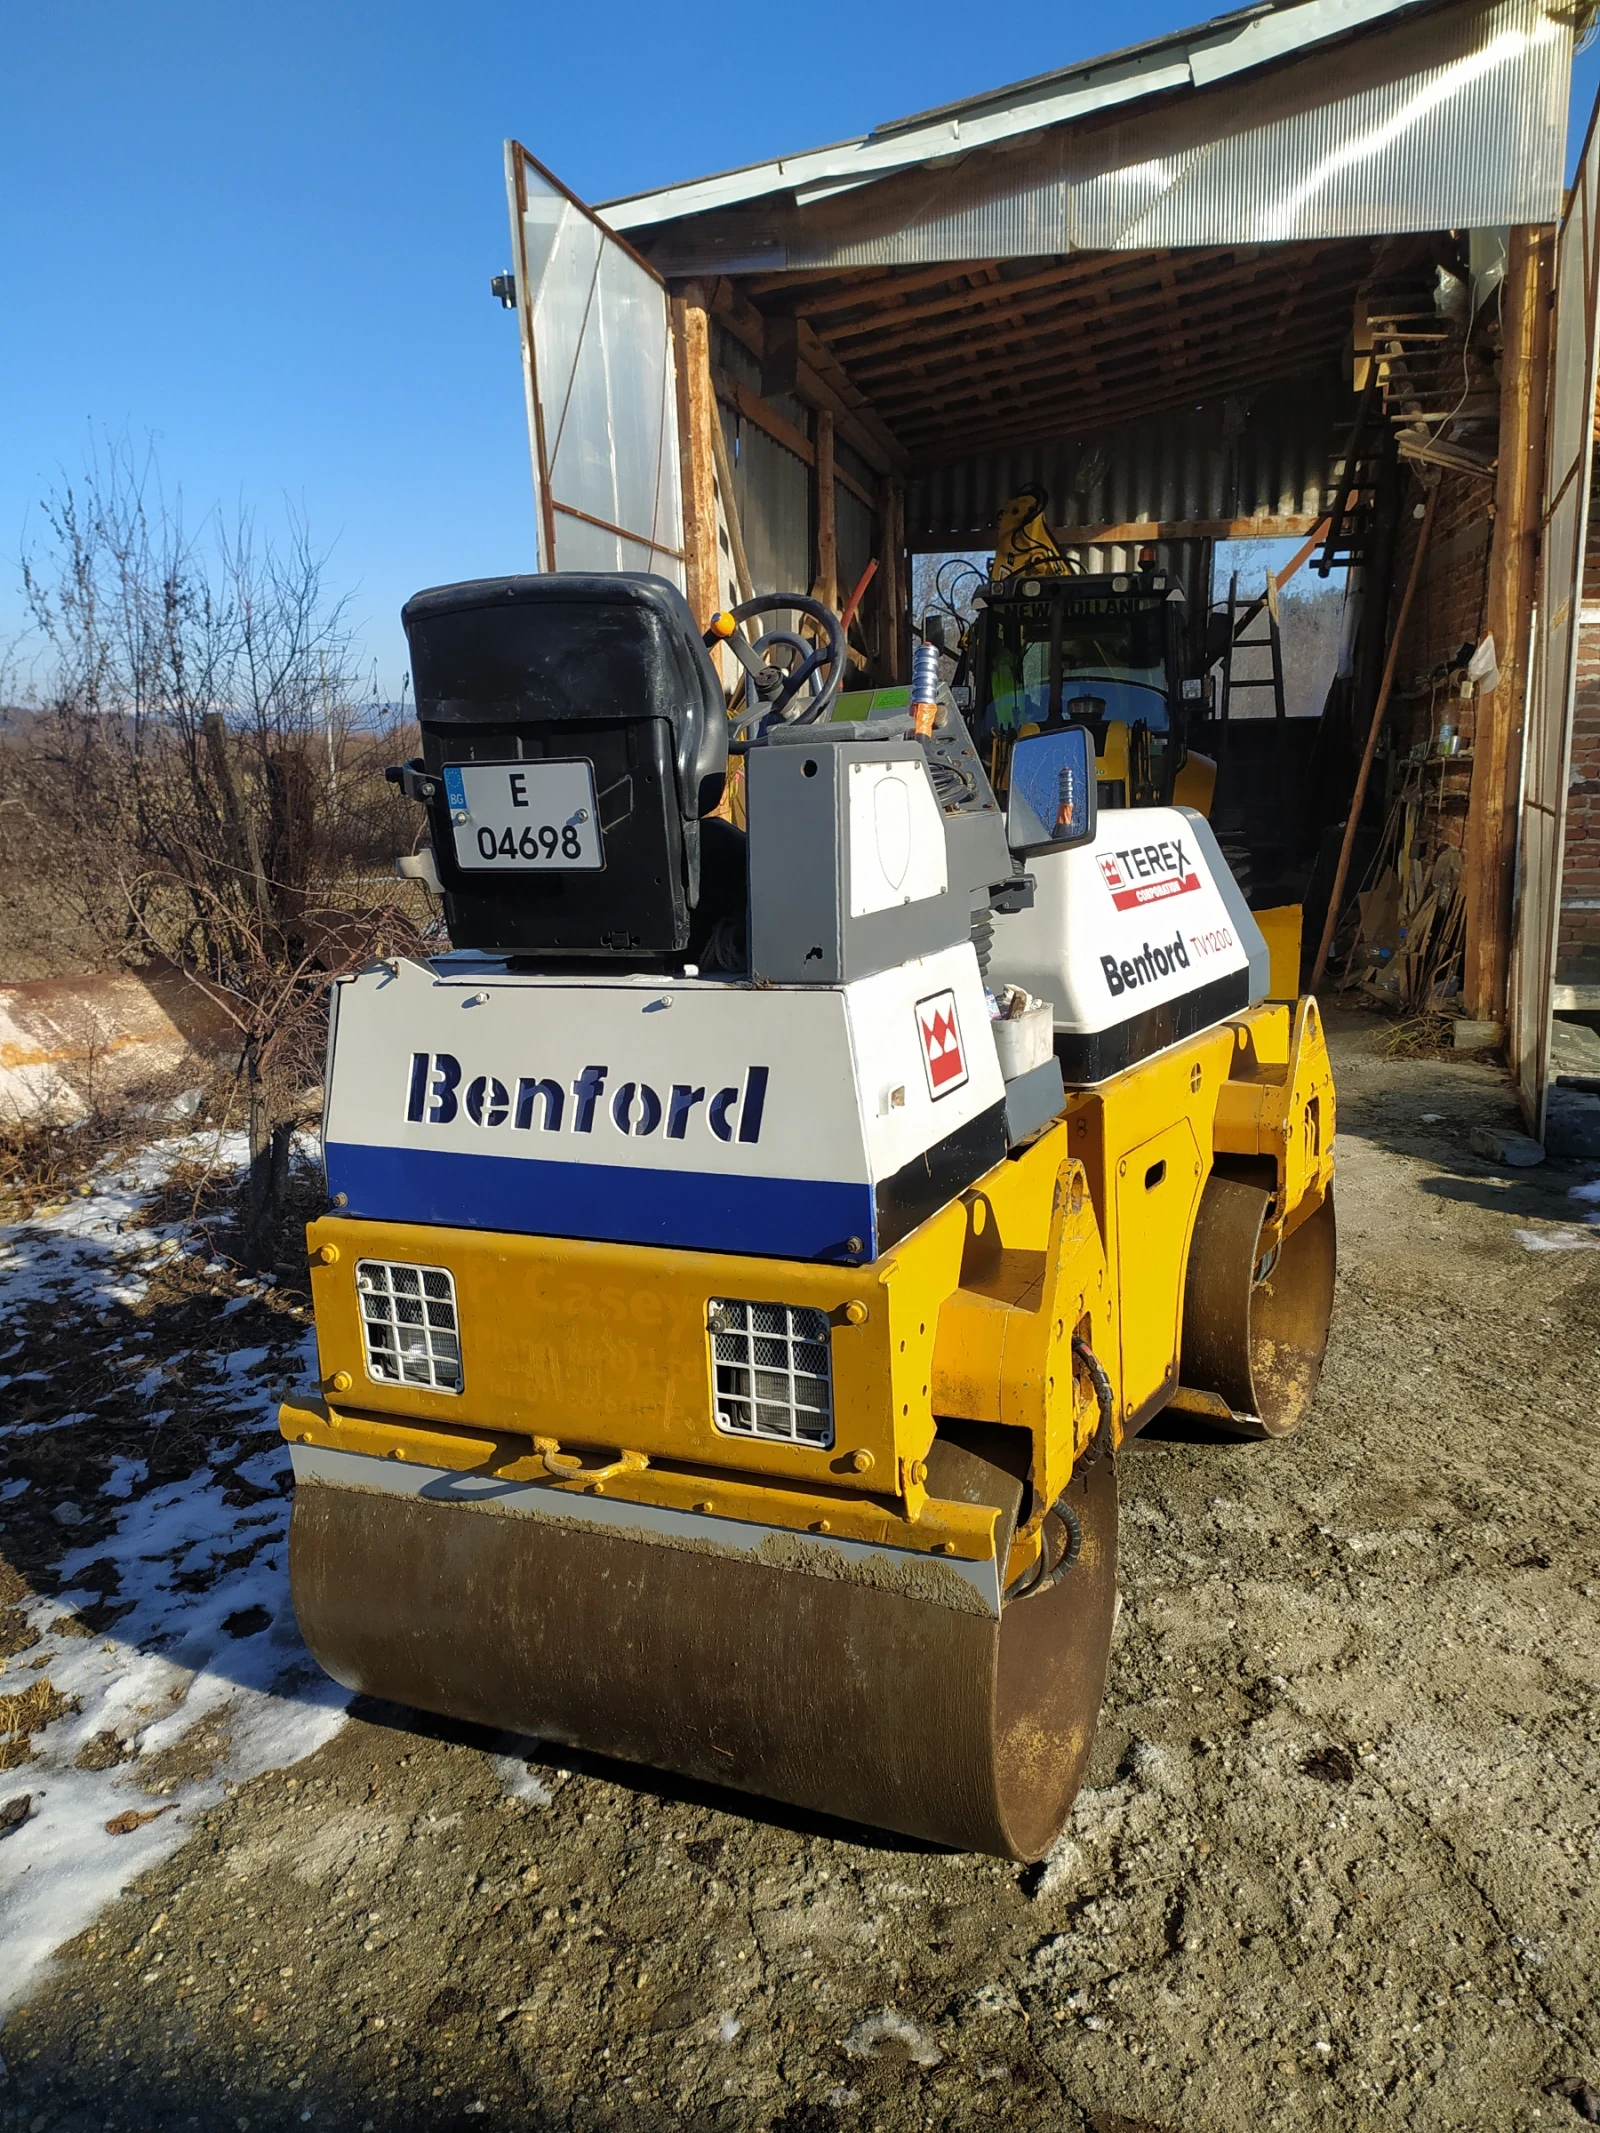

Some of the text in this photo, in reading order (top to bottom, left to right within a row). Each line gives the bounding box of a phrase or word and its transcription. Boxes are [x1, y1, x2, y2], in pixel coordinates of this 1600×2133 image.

[1004, 602, 1050, 617] NEW
[450, 793, 464, 805] BG
[509, 774, 529, 807] E
[477, 825, 582, 860] 04698
[1116, 839, 1191, 879] TEREX
[1136, 881, 1181, 902] CORPORATION
[1100, 928, 1233, 997] Benford TV1200
[404, 1053, 769, 1143] Benford
[523, 1263, 698, 1343] Casey
